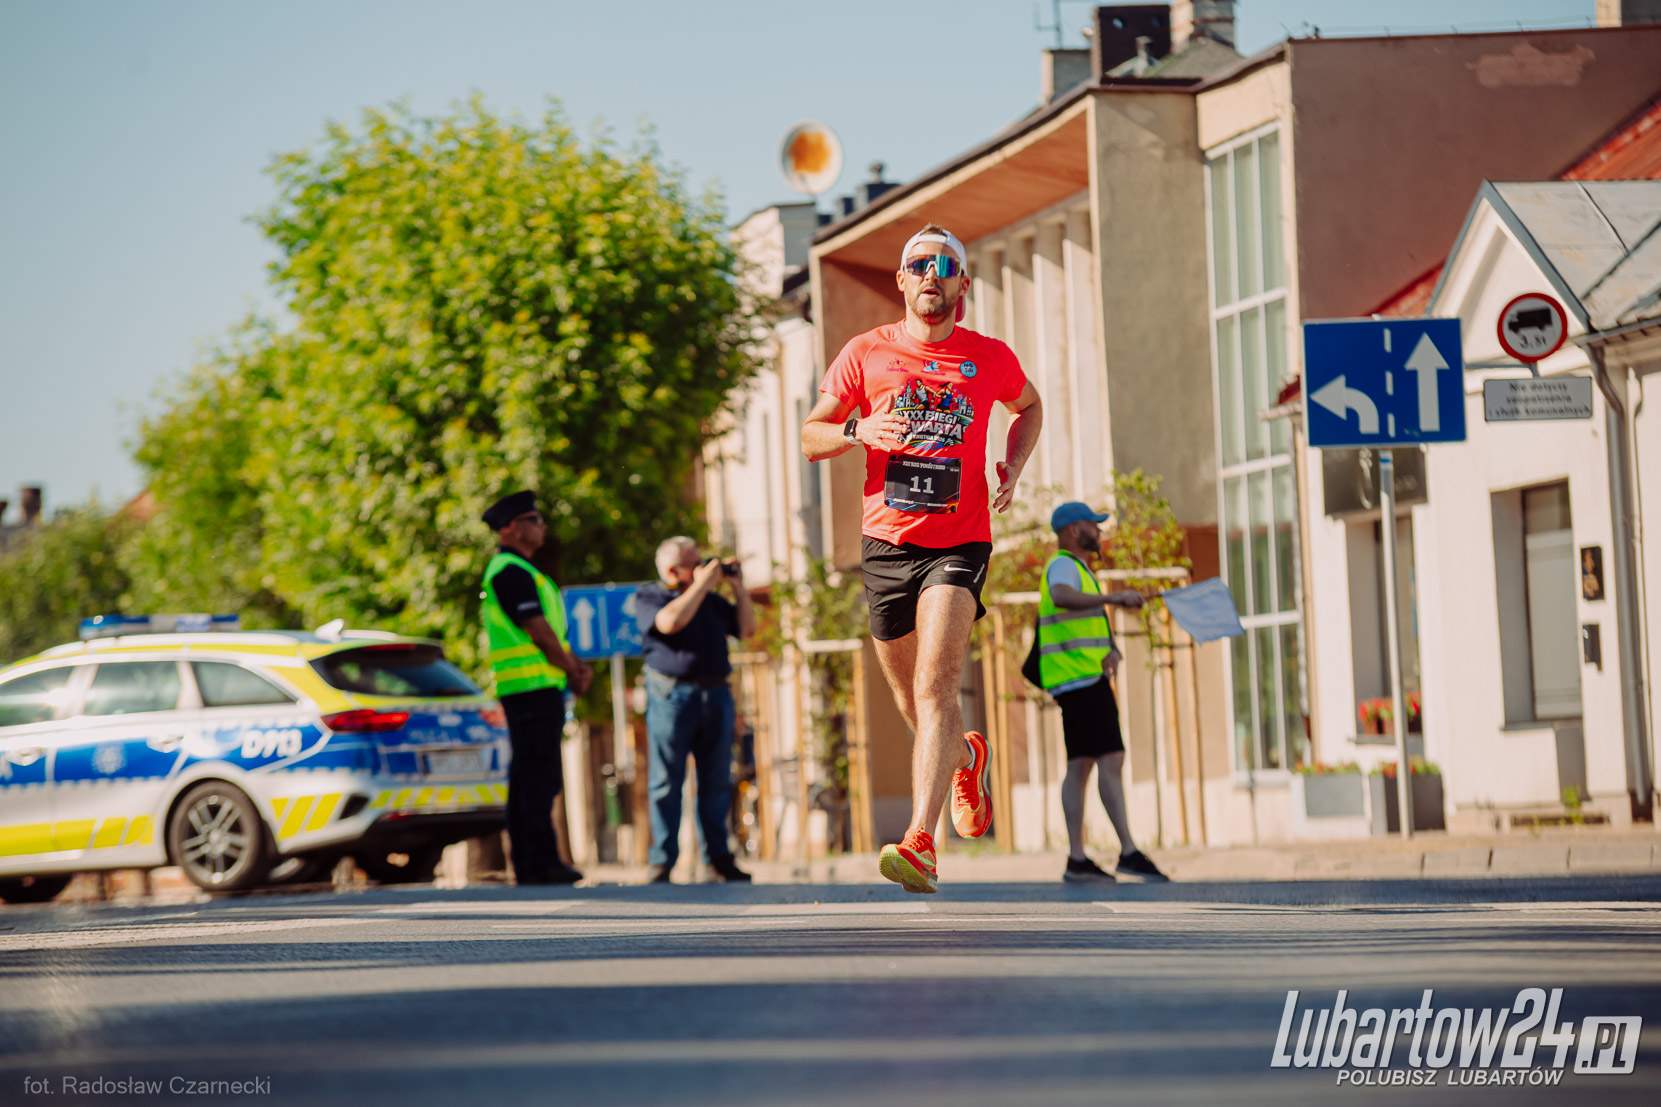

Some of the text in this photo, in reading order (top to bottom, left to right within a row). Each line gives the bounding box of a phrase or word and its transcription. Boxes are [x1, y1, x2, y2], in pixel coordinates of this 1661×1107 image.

[925, 410, 958, 425] BIEGI
[909, 421, 962, 440] WARTA
[909, 475, 934, 494] 11
